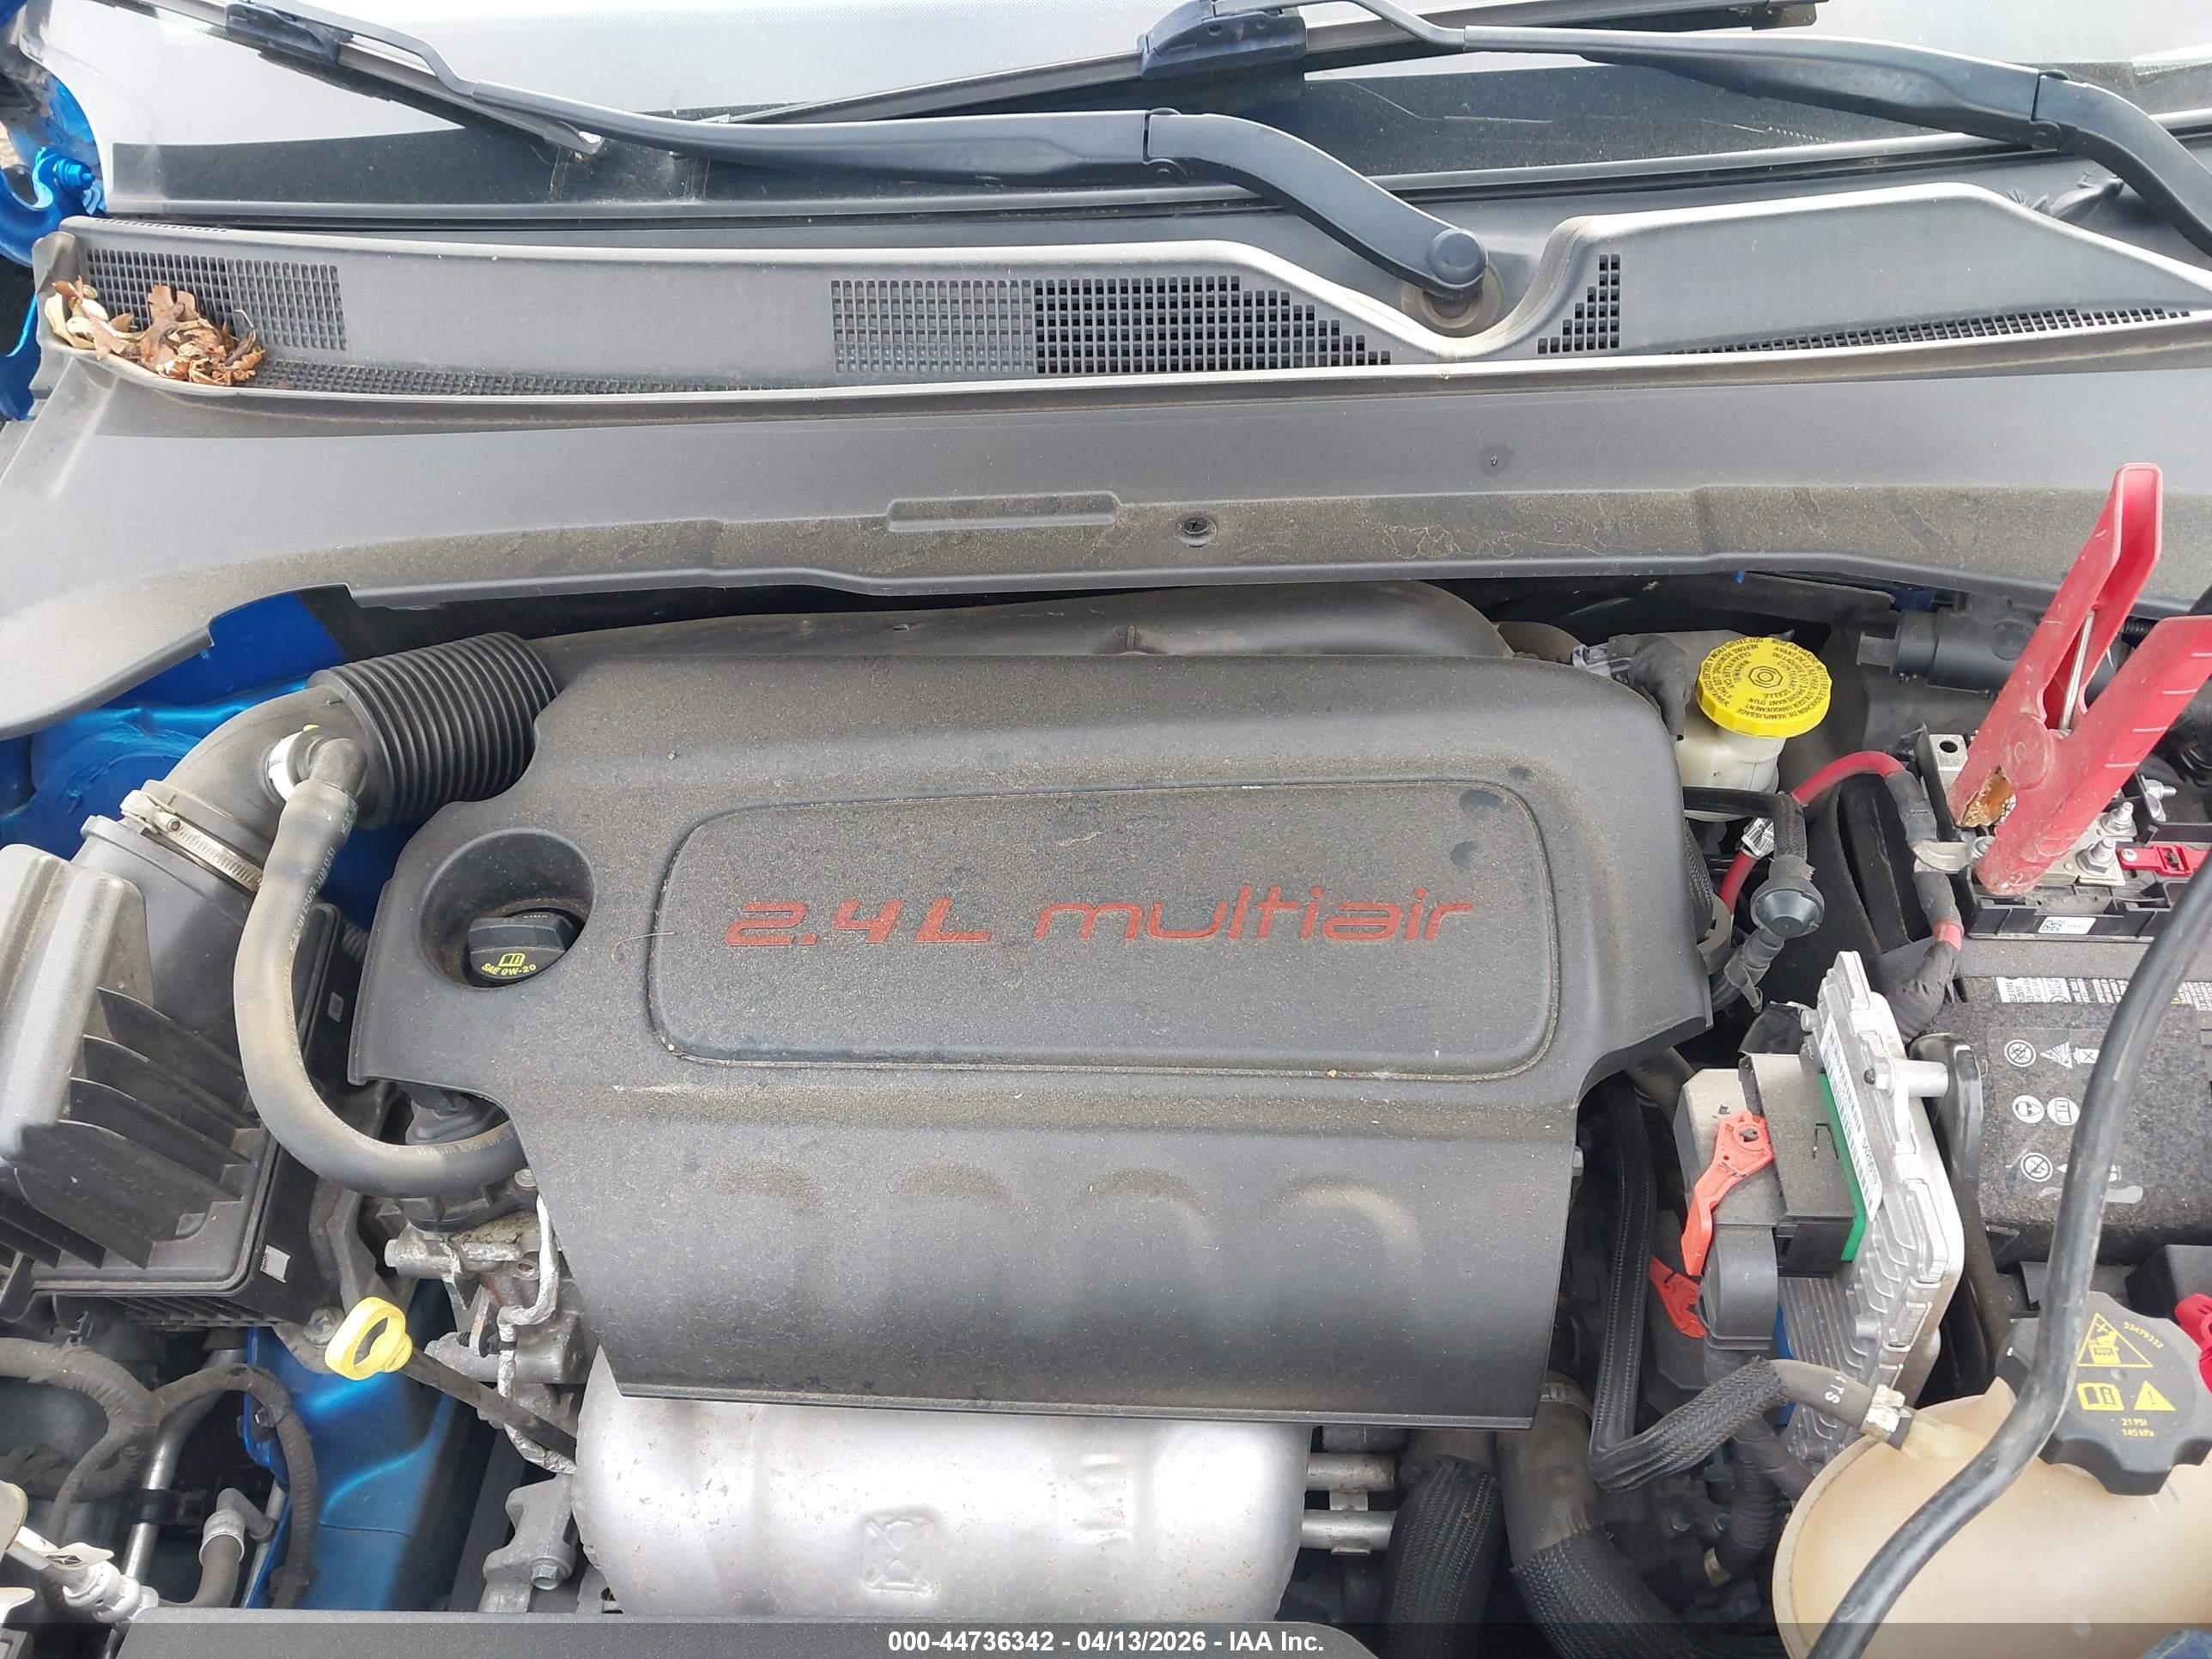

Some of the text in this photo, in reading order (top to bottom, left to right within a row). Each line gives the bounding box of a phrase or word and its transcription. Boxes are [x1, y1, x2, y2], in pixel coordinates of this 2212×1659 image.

[1034, 882, 1474, 941] multiair
[482, 963, 537, 975] SAE 0W-20
[2121, 1418, 2148, 1426] 21 PSI
[2121, 1428, 2155, 1437] 145 kPa
